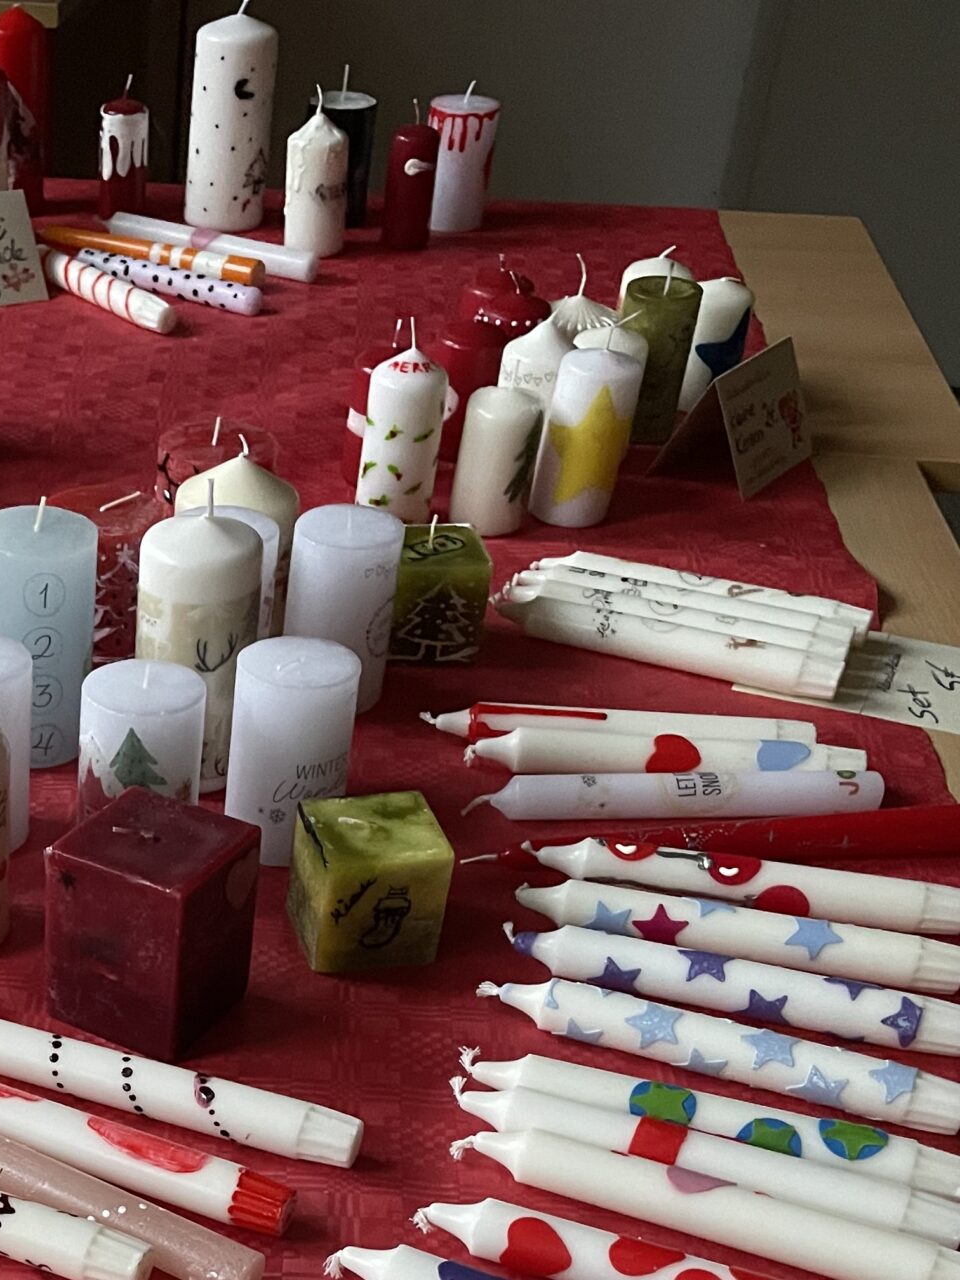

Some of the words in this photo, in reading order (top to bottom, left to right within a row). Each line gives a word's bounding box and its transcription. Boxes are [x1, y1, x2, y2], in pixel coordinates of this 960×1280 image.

[39, 583, 49, 609] 1
[32, 634, 55, 660] 2
[32, 684, 53, 708] 3
[32, 731, 55, 757] 4
[701, 772, 722, 796] SNO
